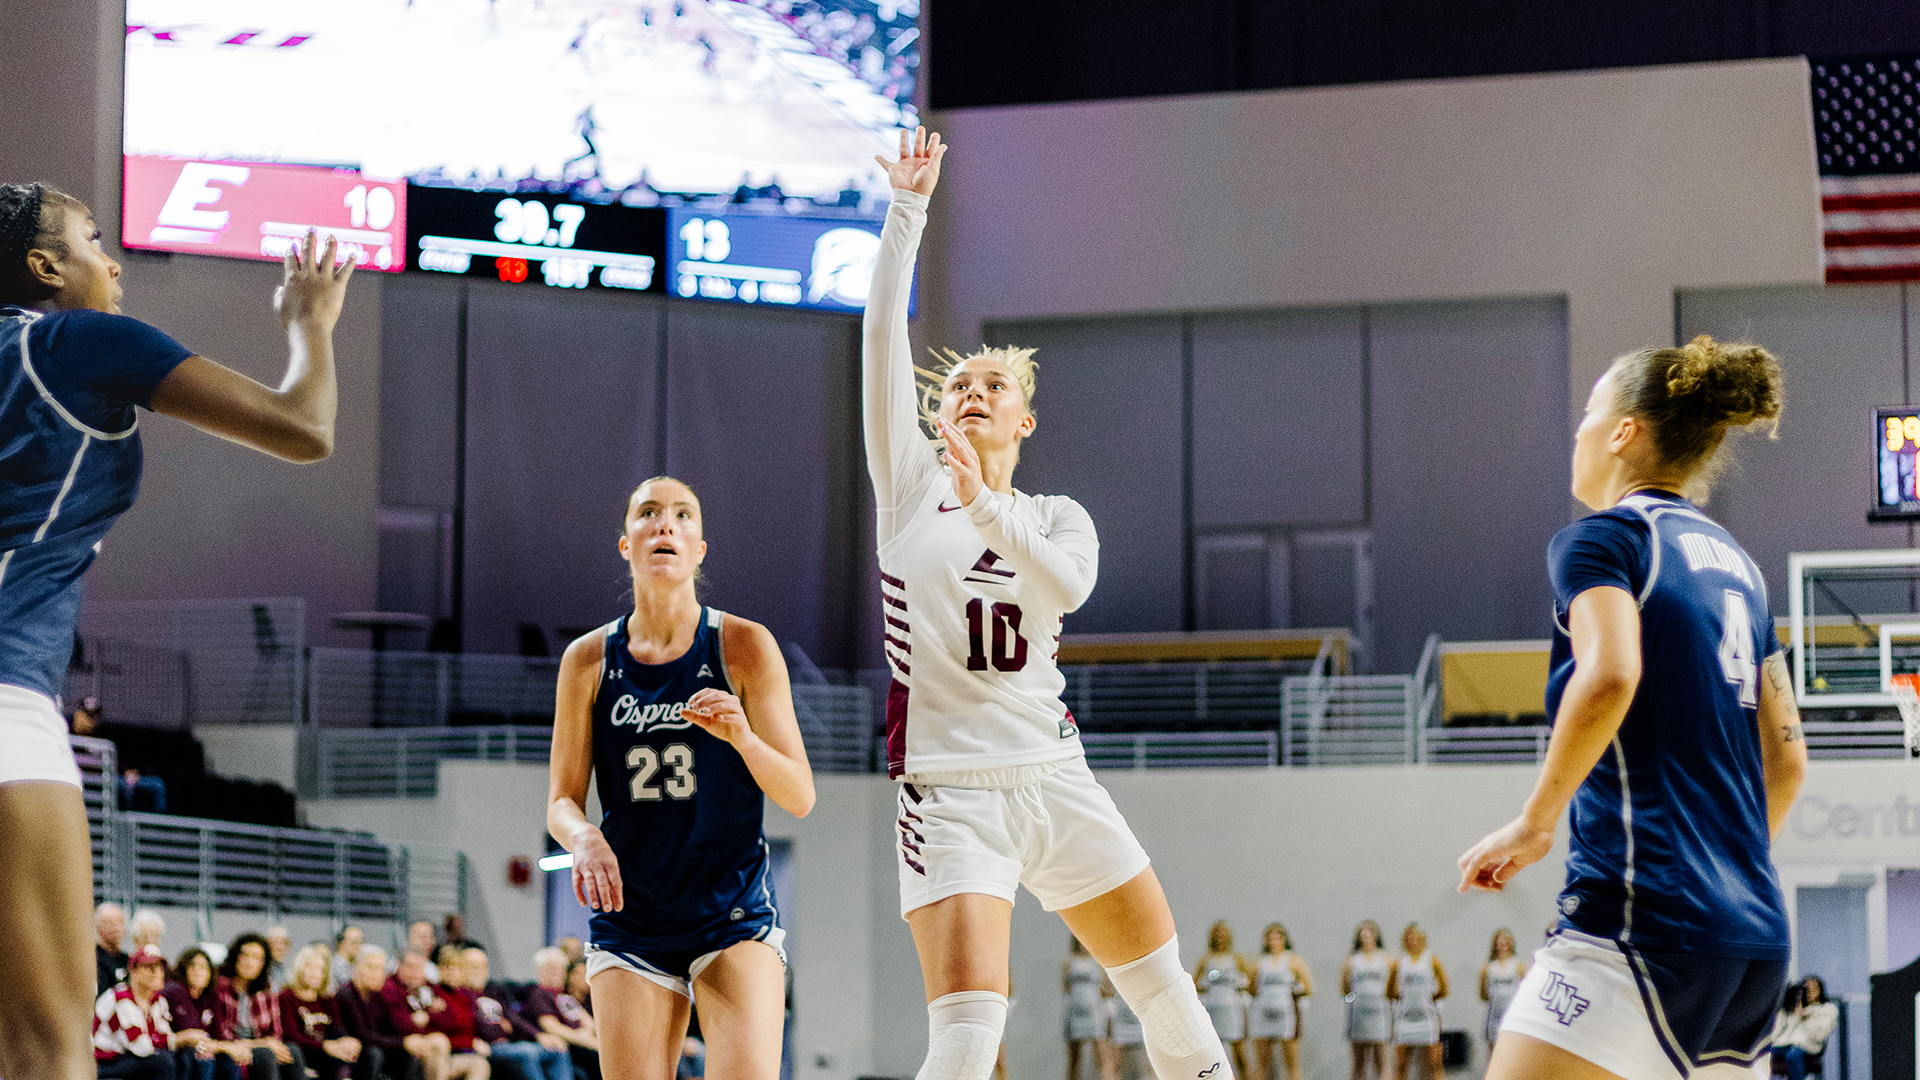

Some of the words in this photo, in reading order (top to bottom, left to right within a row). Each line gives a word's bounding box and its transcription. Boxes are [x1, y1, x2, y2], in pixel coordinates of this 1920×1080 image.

[157, 162, 250, 229] E
[494, 198, 585, 248] 39.7
[680, 217, 730, 262] 13
[966, 598, 1028, 672] 10
[1719, 588, 1757, 709] 4
[611, 694, 693, 733] Ospre
[625, 742, 697, 802] 23
[1790, 794, 1920, 840] Cent
[1540, 971, 1591, 1027] UNF
